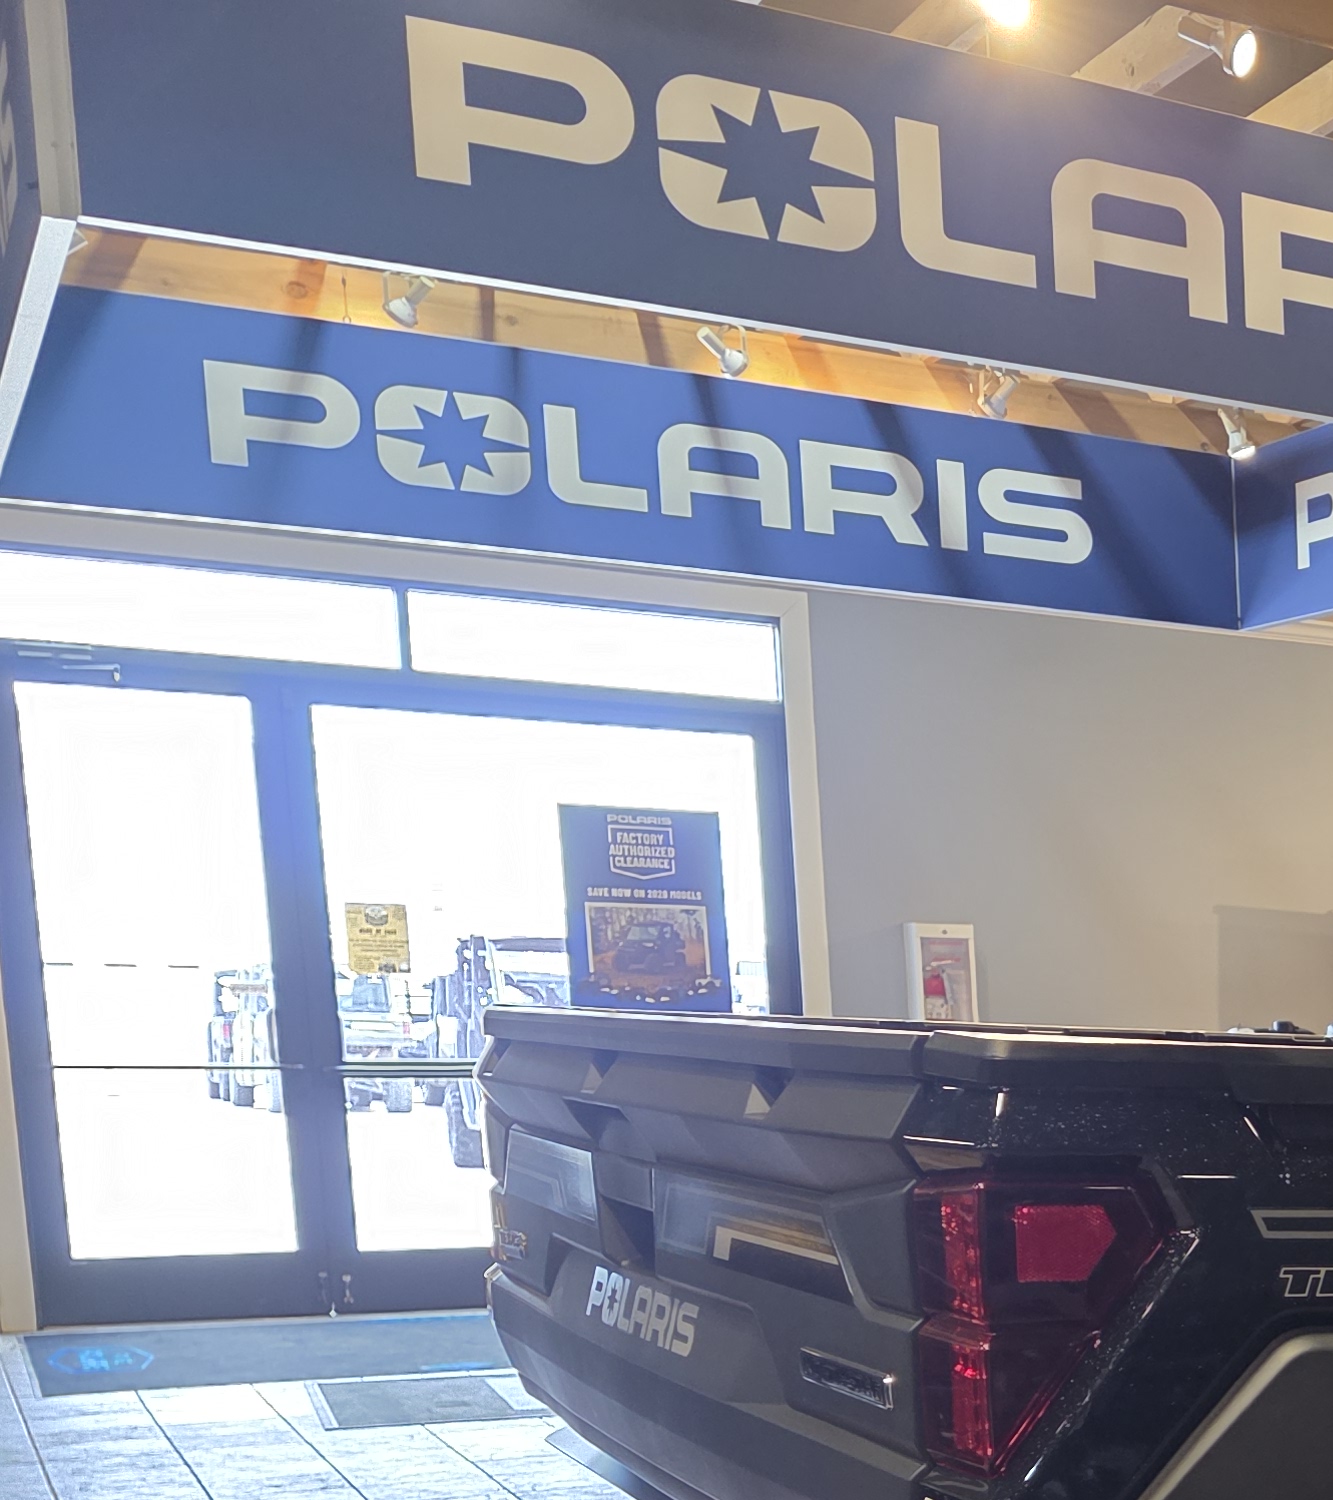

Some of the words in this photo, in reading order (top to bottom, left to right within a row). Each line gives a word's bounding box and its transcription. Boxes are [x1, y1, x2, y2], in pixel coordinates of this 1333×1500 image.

[203, 360, 1093, 565] POLARIS
[607, 814, 672, 825] POLARIS
[617, 832, 664, 845] FACTORY
[609, 845, 675, 858] AUTHORIZED
[615, 857, 670, 869] CLEARANCE
[587, 887, 609, 898] SAVE
[611, 888, 631, 897] NOW
[670, 891, 702, 900] MODELS
[586, 1266, 699, 1357] POLARIS
